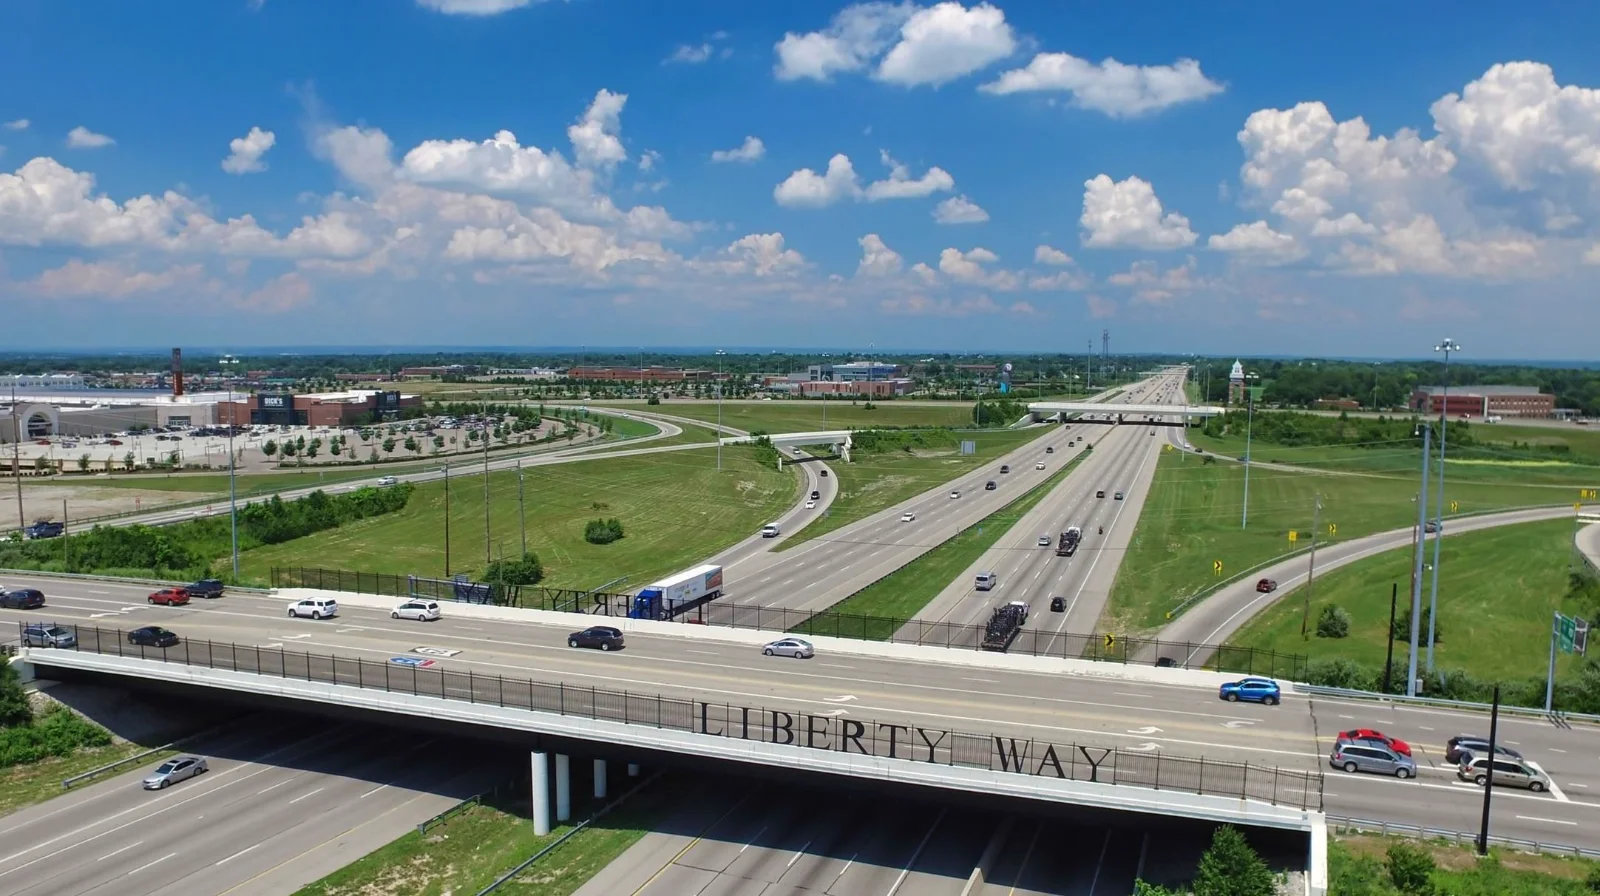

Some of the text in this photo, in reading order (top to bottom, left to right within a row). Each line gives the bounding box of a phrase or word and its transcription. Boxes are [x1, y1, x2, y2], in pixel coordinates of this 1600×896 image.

[264, 397, 283, 405] DICK'S
[700, 702, 1112, 782] LIBERTY WAY
